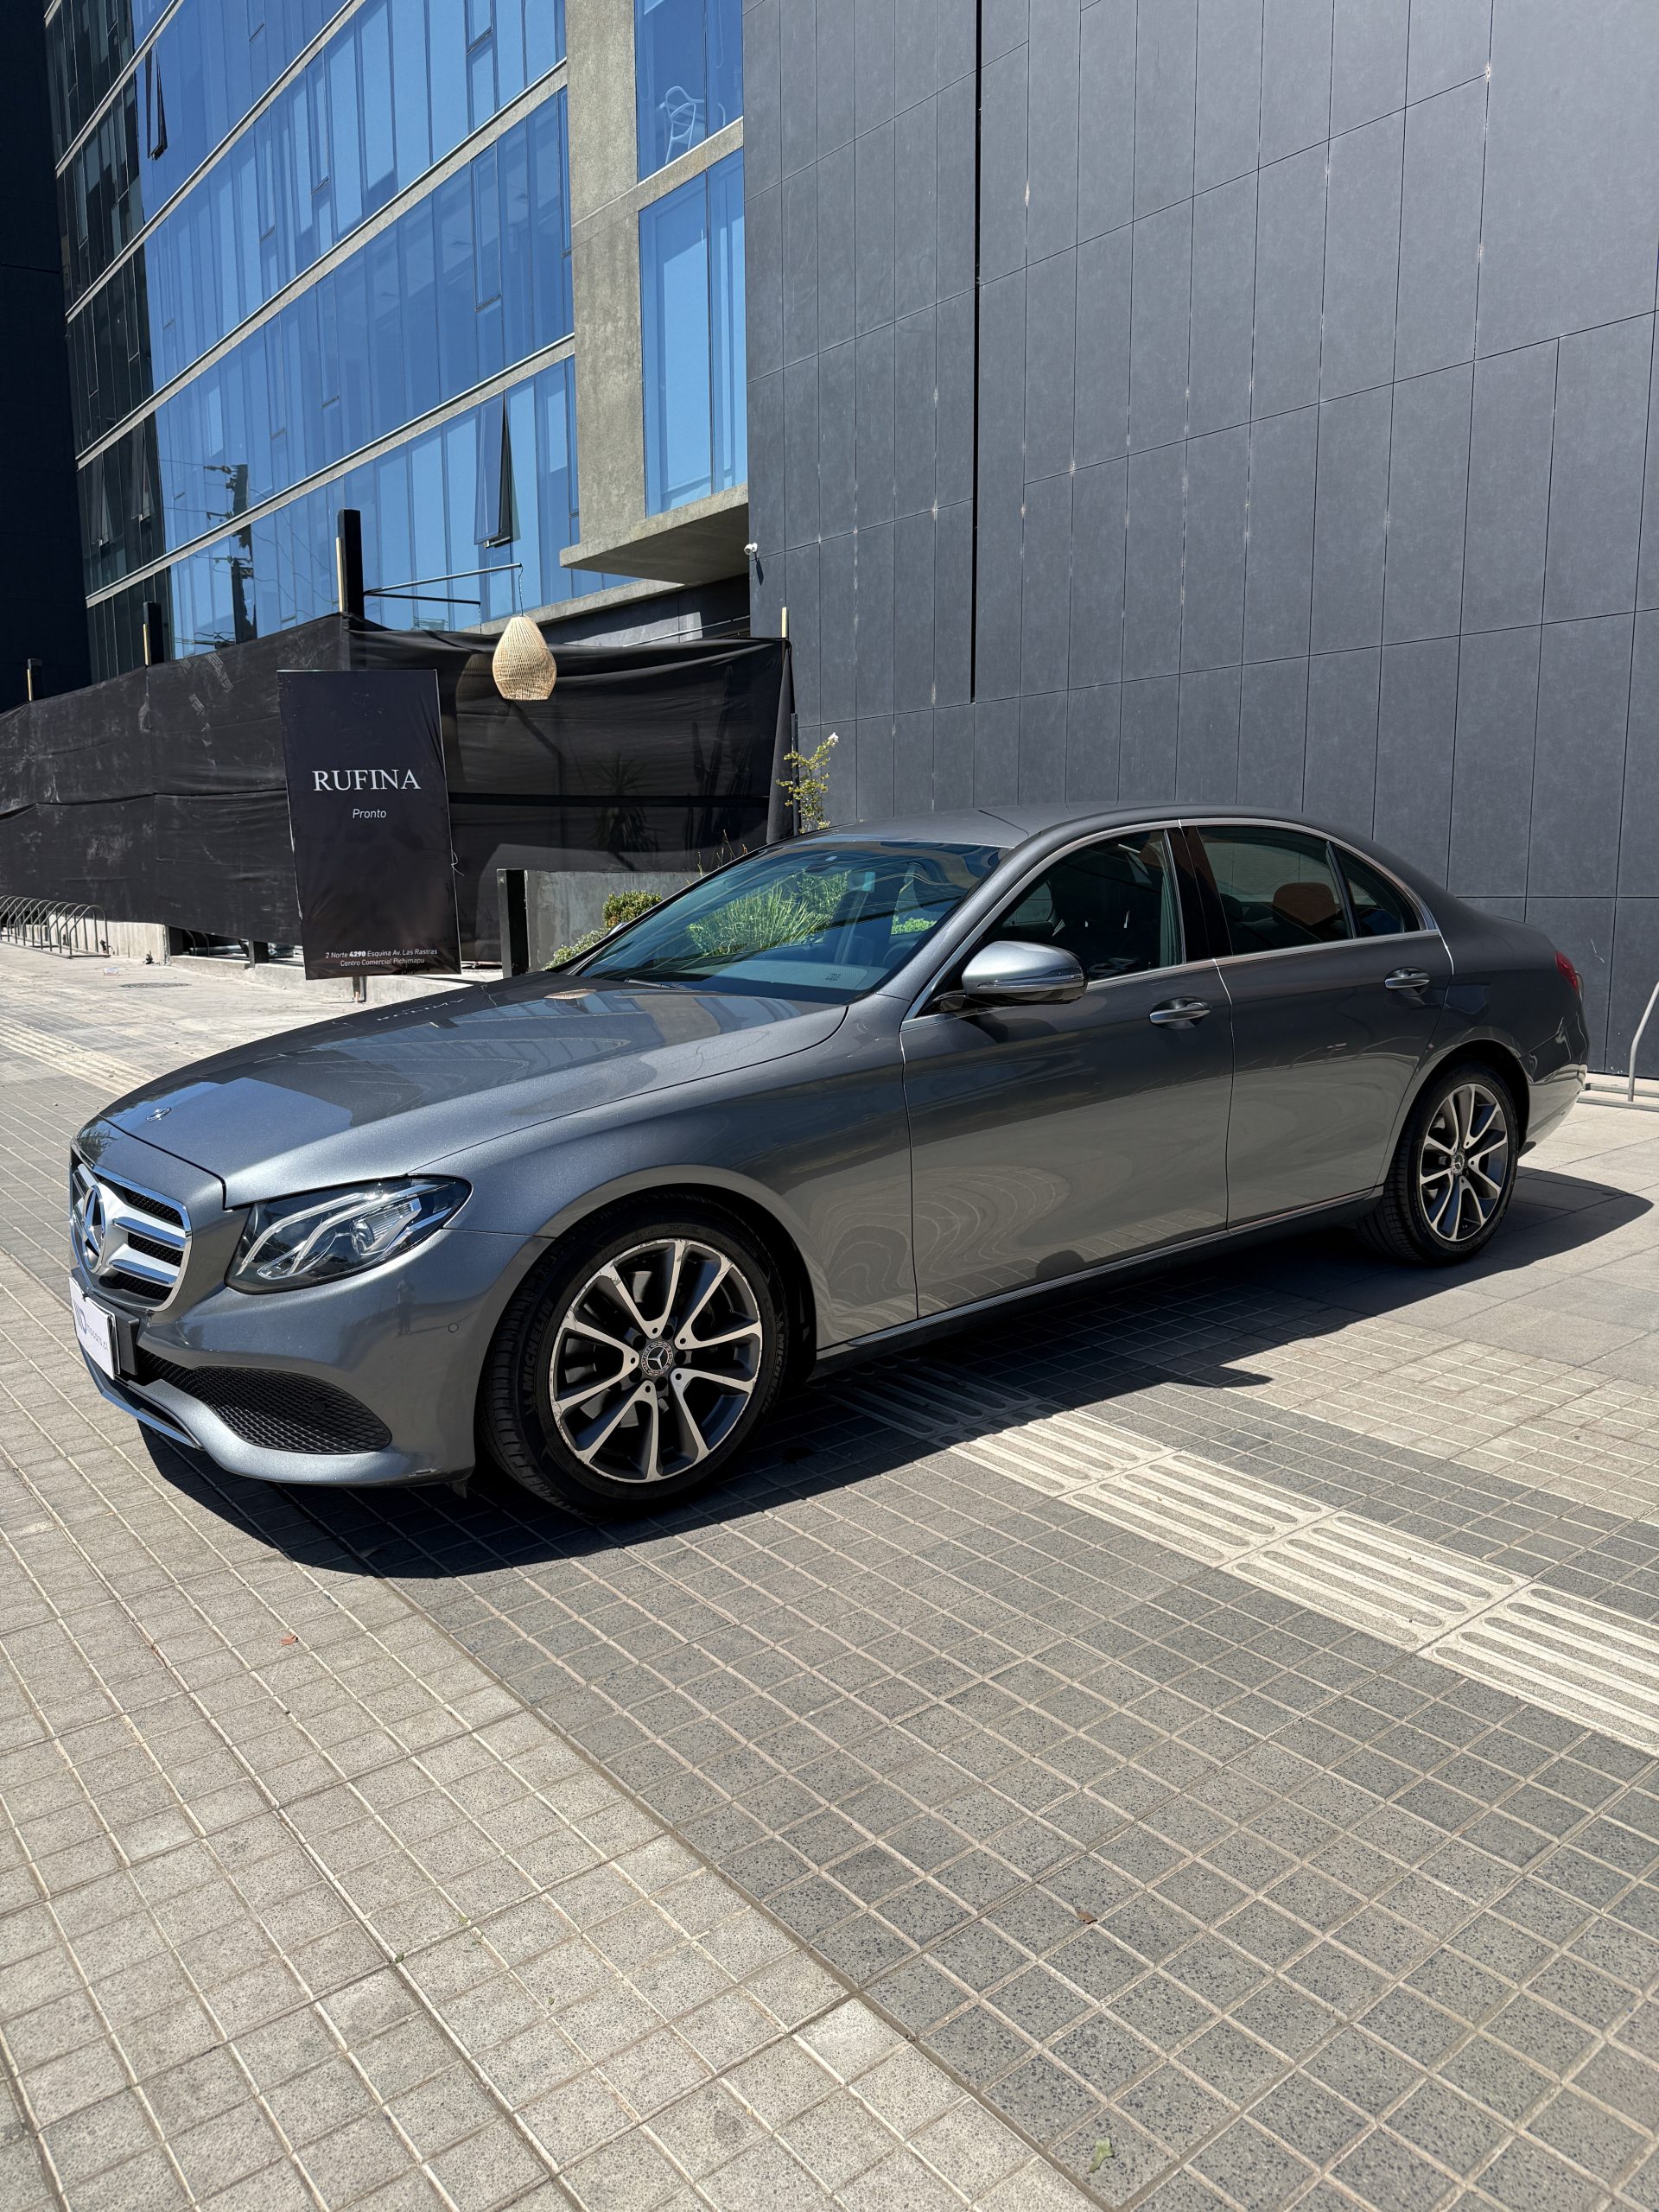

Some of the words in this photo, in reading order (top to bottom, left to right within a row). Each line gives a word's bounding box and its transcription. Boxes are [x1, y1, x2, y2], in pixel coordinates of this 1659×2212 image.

[312, 768, 422, 791] RUFINA
[353, 808, 387, 819] Pronto
[367, 950, 391, 958] Esquina
[523, 1300, 553, 1393] MICHELIN
